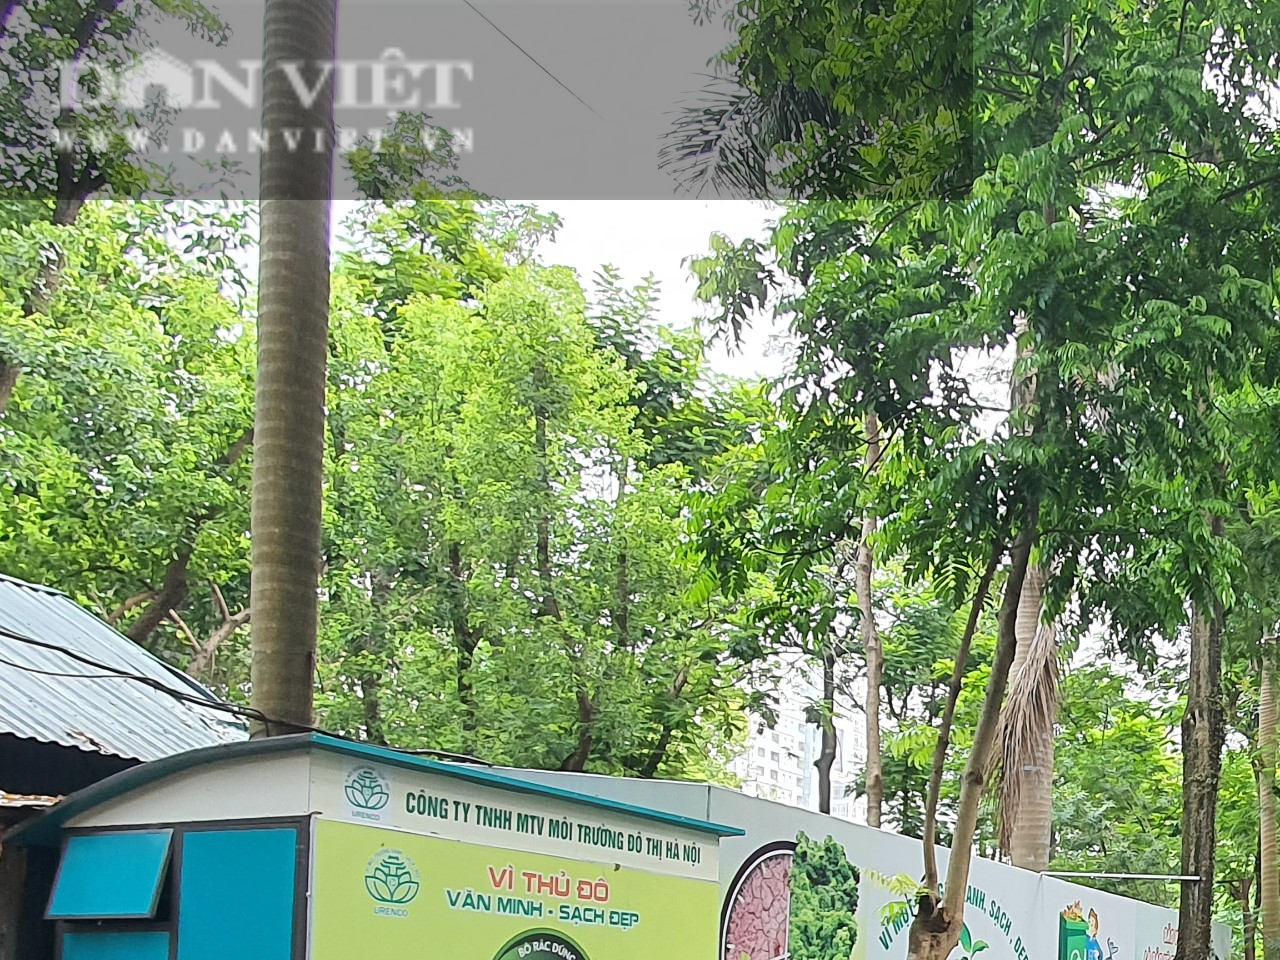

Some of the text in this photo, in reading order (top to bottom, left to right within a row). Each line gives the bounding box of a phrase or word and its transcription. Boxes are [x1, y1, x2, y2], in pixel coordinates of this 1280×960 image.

[352, 810, 381, 821] URENCO
[406, 789, 701, 866] CÔNG TY TNHH MTV MÔI TRƯỜNG ĐÔ THỊ HÀ NỘI
[488, 865, 609, 901] VÌ THỦ ĐÔ
[374, 906, 408, 917] URENCO
[447, 890, 491, 911] VĂN
[497, 897, 542, 917] MINH
[559, 905, 604, 925] SẠCH
[609, 911, 639, 930] ĐẸP
[964, 885, 986, 914] ANH,
